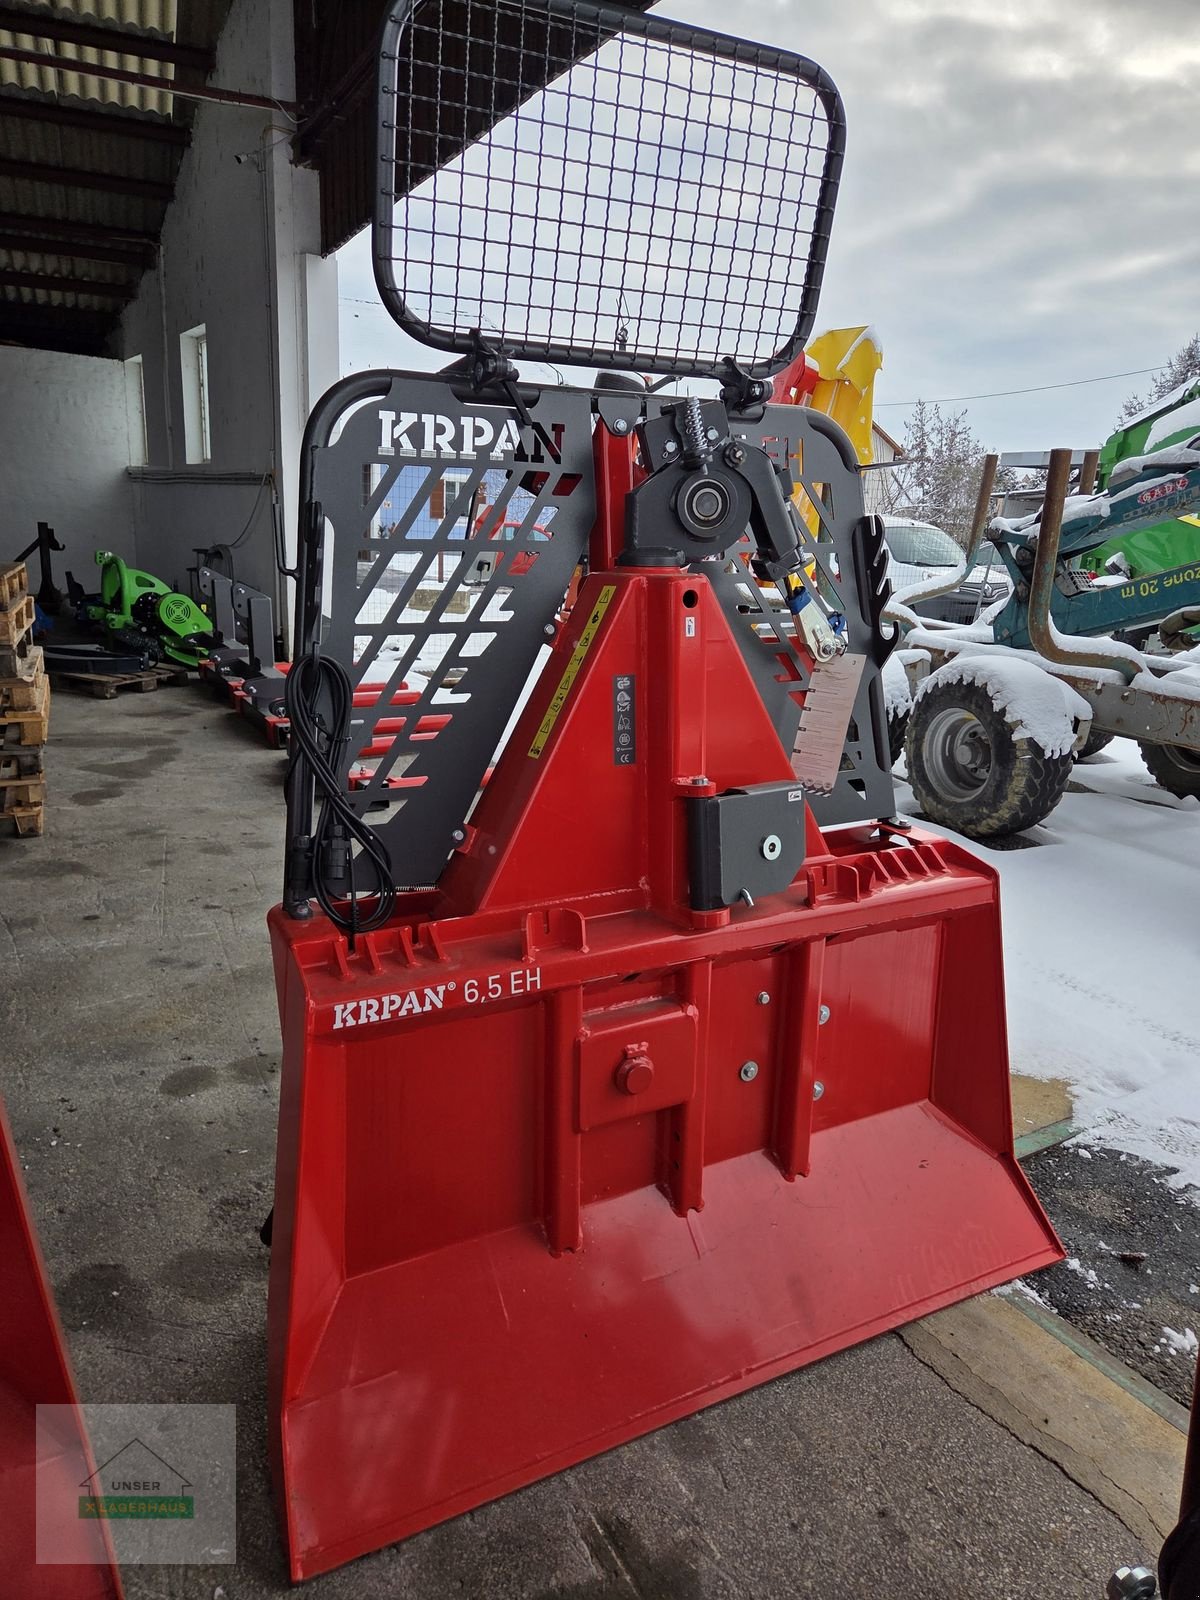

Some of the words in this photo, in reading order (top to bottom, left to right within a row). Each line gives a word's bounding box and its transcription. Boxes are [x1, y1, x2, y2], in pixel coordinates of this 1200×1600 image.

[377, 410, 566, 465] KRPAN
[1121, 585, 1135, 599] m
[1139, 579, 1159, 597] 20
[464, 975, 502, 1004] 6,5
[510, 967, 541, 995] EH
